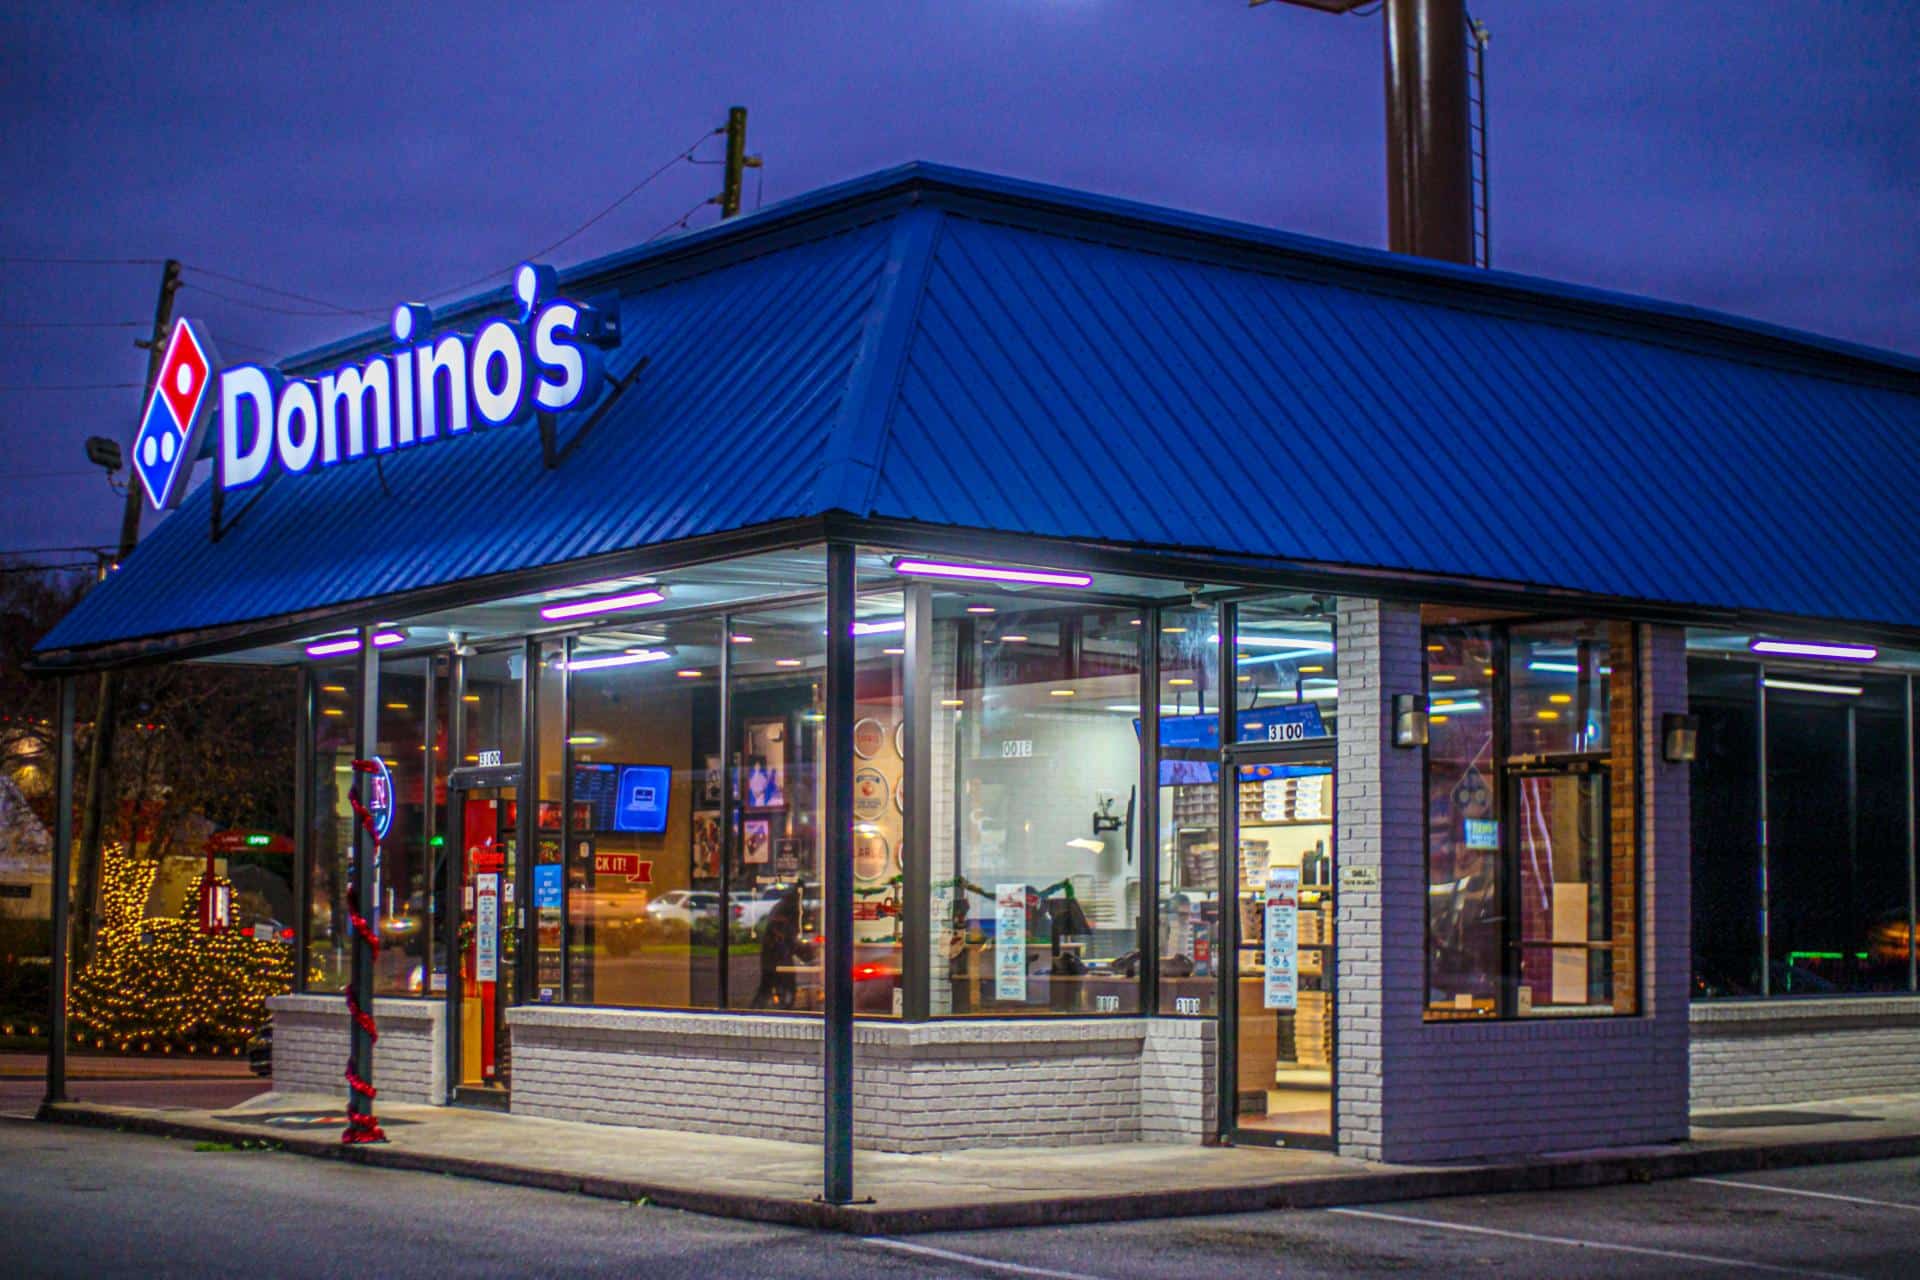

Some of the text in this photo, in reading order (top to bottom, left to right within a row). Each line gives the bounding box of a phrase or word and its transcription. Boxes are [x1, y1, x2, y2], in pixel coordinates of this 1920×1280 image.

[220, 264, 585, 490] Domino's
[1269, 723, 1303, 740] 3100
[595, 857, 627, 871] CK IT!
